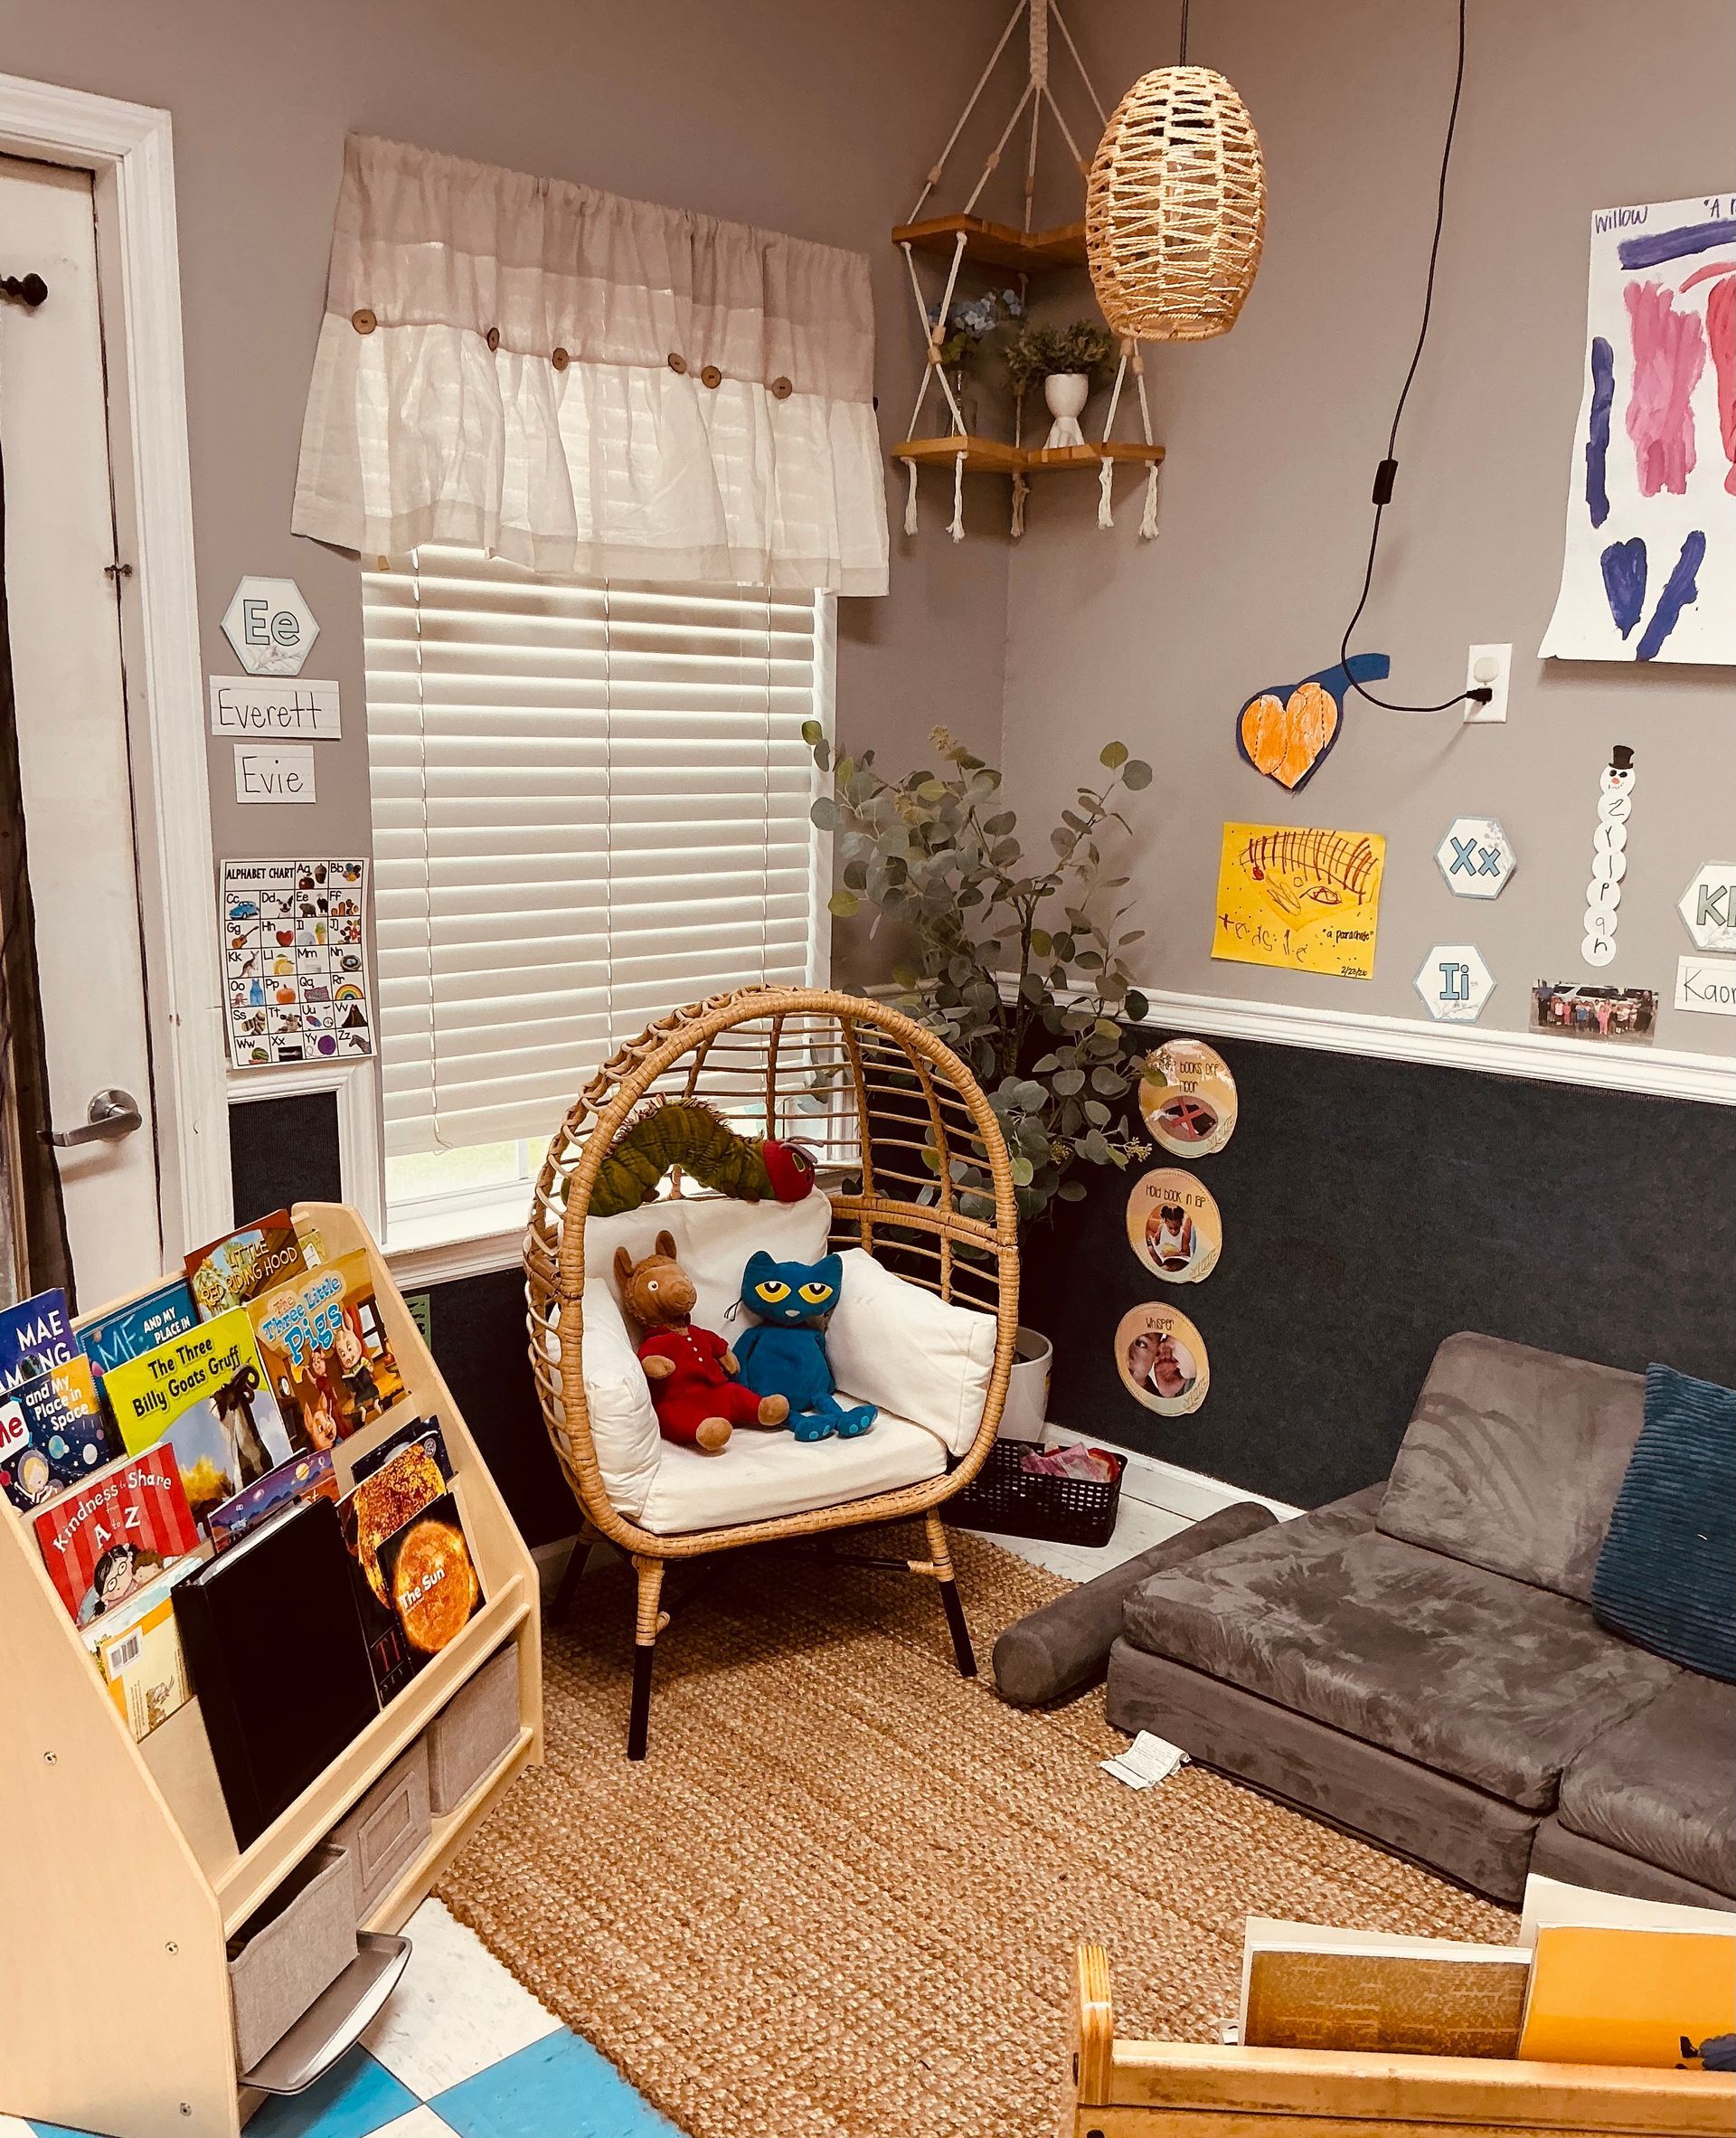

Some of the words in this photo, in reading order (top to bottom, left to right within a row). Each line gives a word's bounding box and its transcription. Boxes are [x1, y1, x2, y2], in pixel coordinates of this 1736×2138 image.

[243, 599, 300, 647] Ee
[218, 688, 323, 729] Everett
[242, 756, 304, 794] Evie
[1449, 837, 1501, 877] Xx
[226, 867, 266, 879] ALPHABET
[269, 867, 295, 878] CHART
[297, 864, 311, 875] Aa
[330, 863, 344, 873] Bb
[226, 894, 240, 904] Cc
[261, 893, 276, 903] Dd
[297, 892, 309, 902] Ee
[329, 891, 342, 901] Ff
[227, 922, 241, 935] Gg
[261, 921, 276, 932] Hh
[228, 951, 242, 962] Kk
[263, 951, 273, 960] Ll
[297, 949, 317, 959] Mm
[330, 947, 344, 957] Nn
[231, 980, 245, 991] Oo
[266, 979, 279, 991] Pp
[300, 977, 315, 989] Qq
[333, 974, 345, 985] Rr
[1439, 962, 1469, 1000] Ii
[268, 1007, 280, 1017] Tt
[302, 1005, 316, 1015] Uu
[335, 1002, 349, 1012] Vv
[233, 1010, 247, 1021] Ss
[271, 1036, 286, 1046] Xx
[305, 1033, 317, 1045] Yy
[338, 1030, 352, 1040] Zz
[237, 1039, 255, 1049] Ww
[227, 1239, 269, 1268] LITTLE
[203, 1283, 226, 1306] RED
[226, 1263, 263, 1294] RIDING
[263, 1247, 297, 1276] HOOD
[262, 1303, 306, 1341] Three
[304, 1277, 342, 1310] Little
[273, 1295, 295, 1315] The
[144, 1315, 162, 1333] AND
[163, 1307, 176, 1323] MY
[16, 1310, 64, 1351] MAE
[154, 1320, 181, 1344] PLACE
[181, 1316, 191, 1330] IN
[283, 1302, 344, 1367] Pigs
[148, 1359, 176, 1379] The
[176, 1338, 213, 1366] Three
[132, 1389, 168, 1418] Billy
[168, 1370, 206, 1398] Goats
[208, 1344, 241, 1376] Gruff
[26, 1383, 51, 1406] and
[34, 1395, 70, 1422] Place
[70, 1388, 82, 1402] in
[51, 1404, 89, 1431] Space
[52, 1484, 118, 1553] Kindness
[127, 1469, 172, 1490] Share
[93, 1524, 111, 1549] A
[111, 1519, 121, 1530] to
[124, 1506, 141, 1529] Z
[399, 1585, 422, 1609] The
[422, 1567, 446, 1591] Sun
